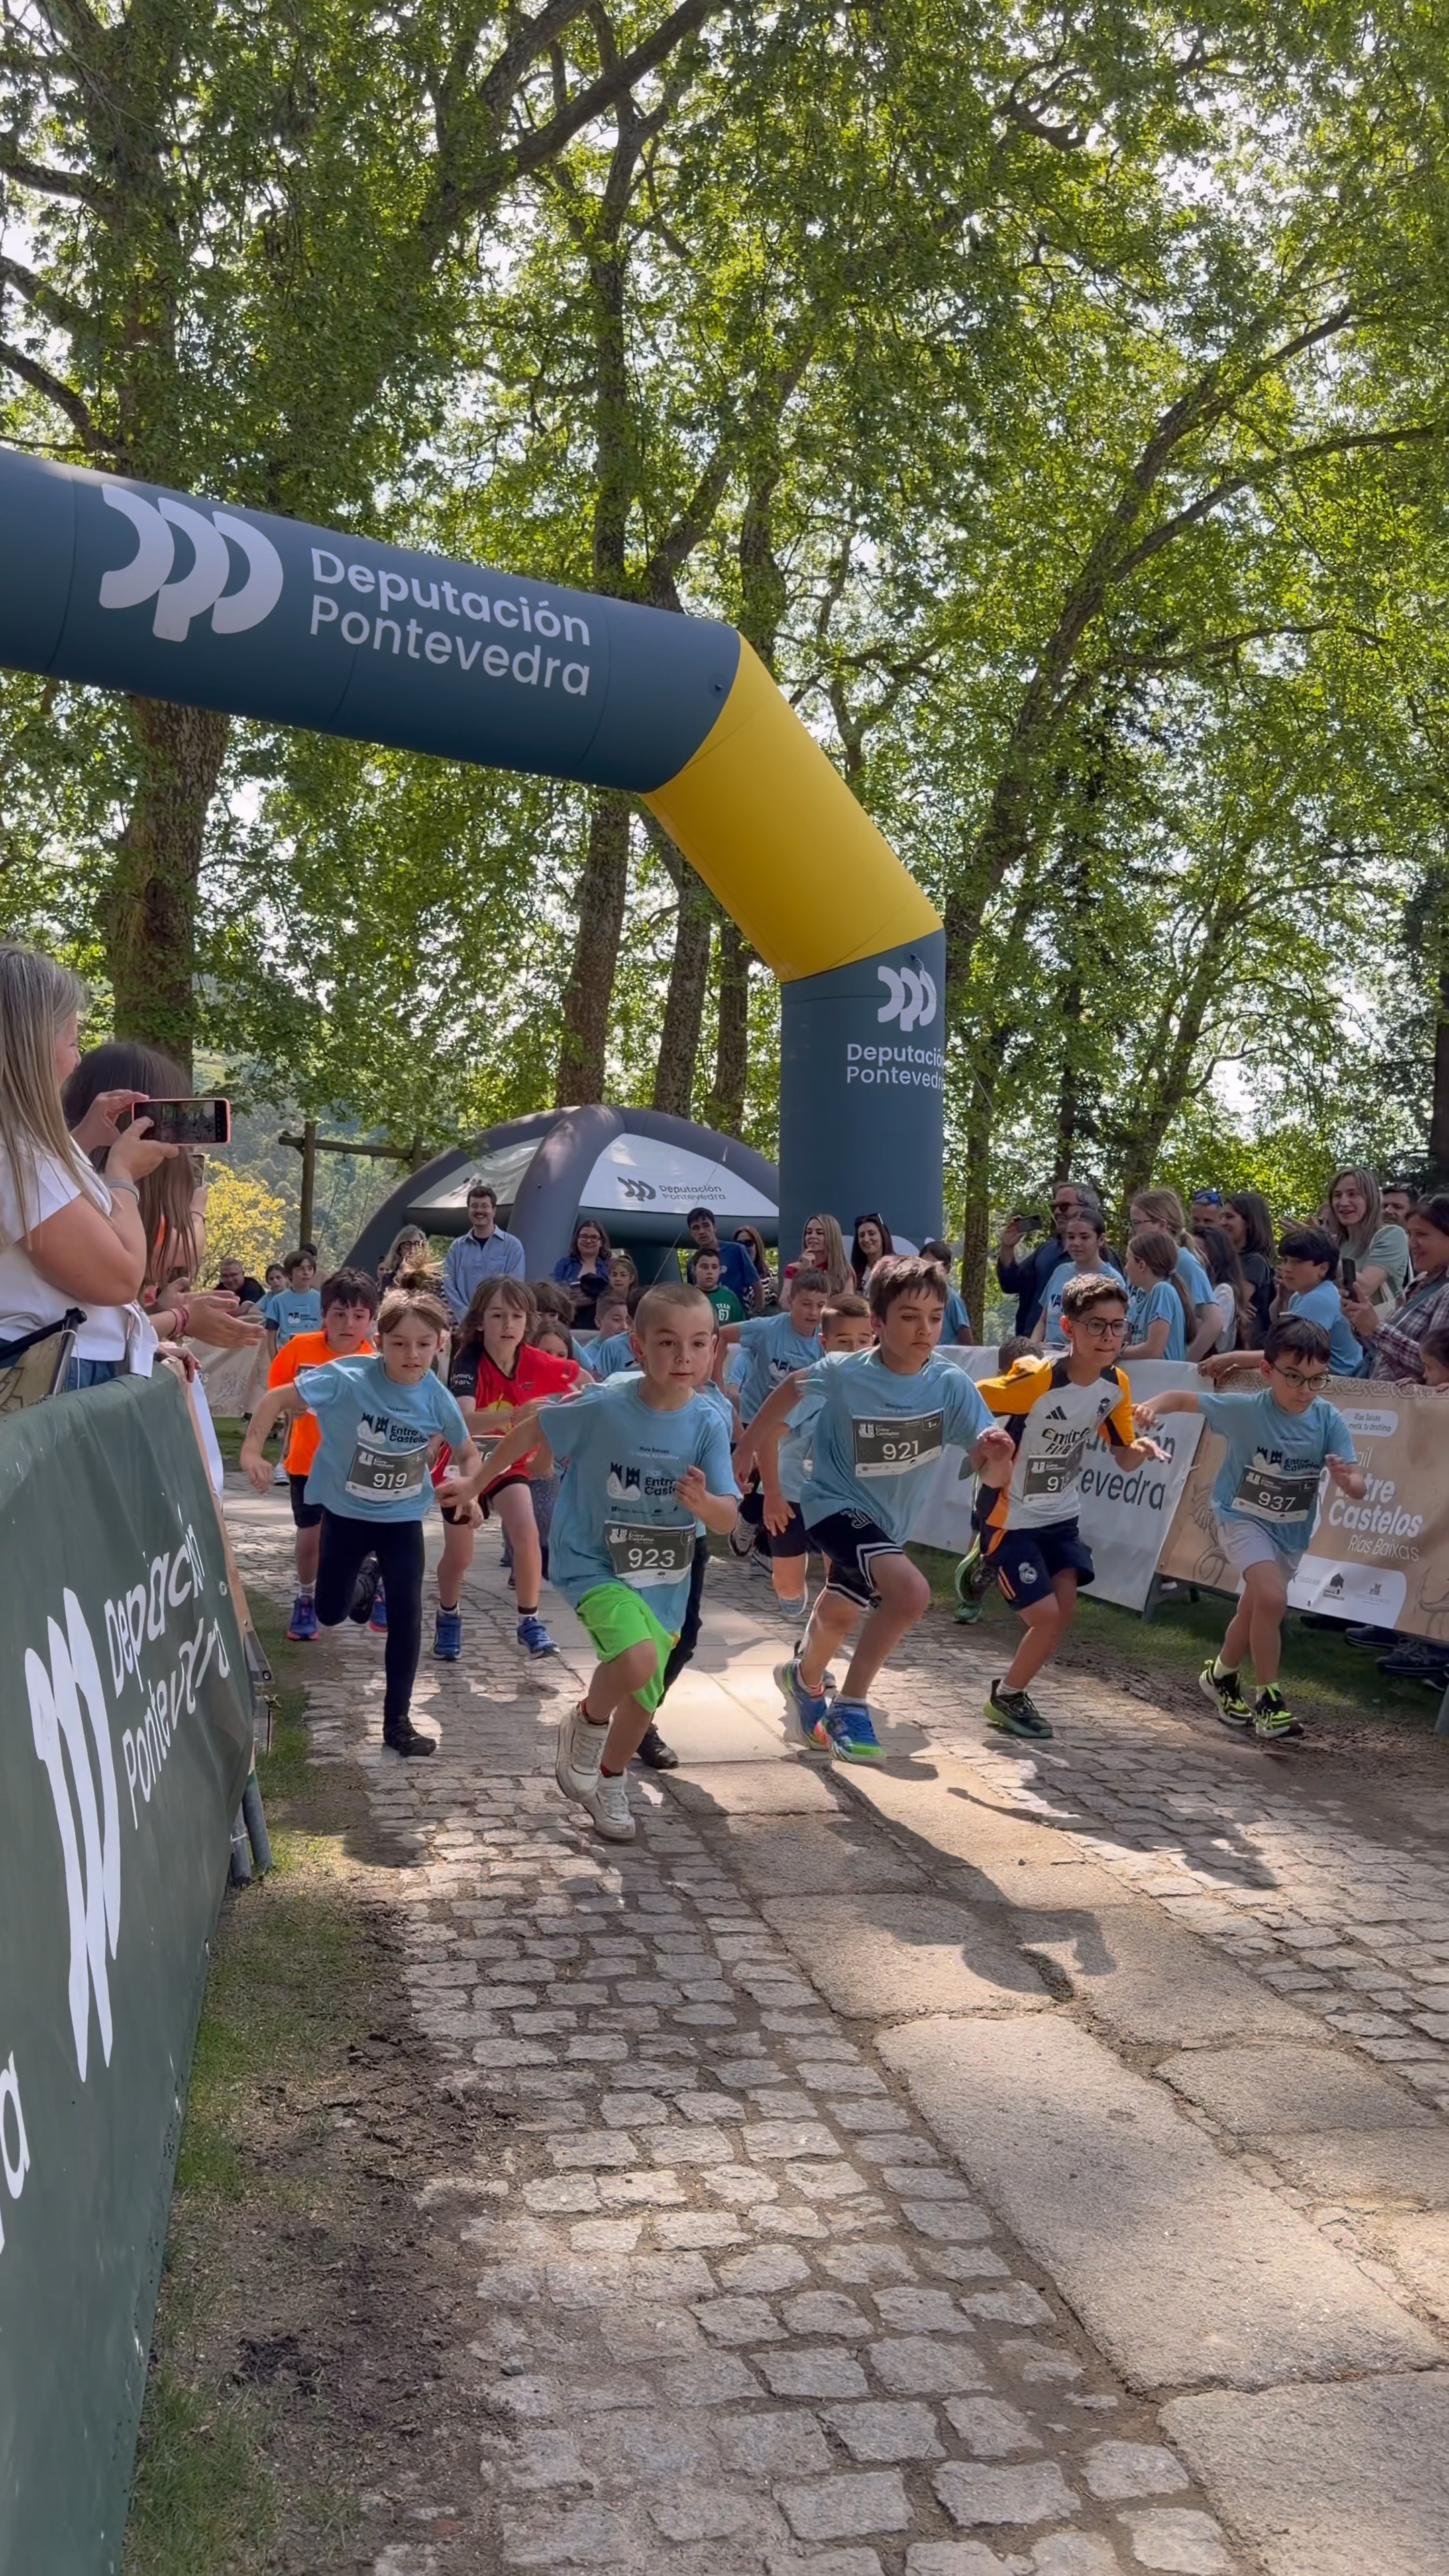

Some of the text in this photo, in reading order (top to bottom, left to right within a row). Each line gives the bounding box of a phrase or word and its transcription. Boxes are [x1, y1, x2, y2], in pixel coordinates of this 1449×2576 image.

[311, 547, 591, 646] Deputación
[310, 594, 590, 696] Pontevedra
[659, 1184, 722, 1194] Deputación
[882, 1440, 918, 1460] 921
[1356, 1447, 1373, 1468] ail
[373, 1472, 407, 1489] 919
[1075, 1466, 1166, 1510] evedra
[1258, 1491, 1297, 1511] 937
[1329, 1499, 1423, 1538] Castelos
[628, 1548, 676, 1568] 923
[1348, 1534, 1419, 1562] Rías Baixas
